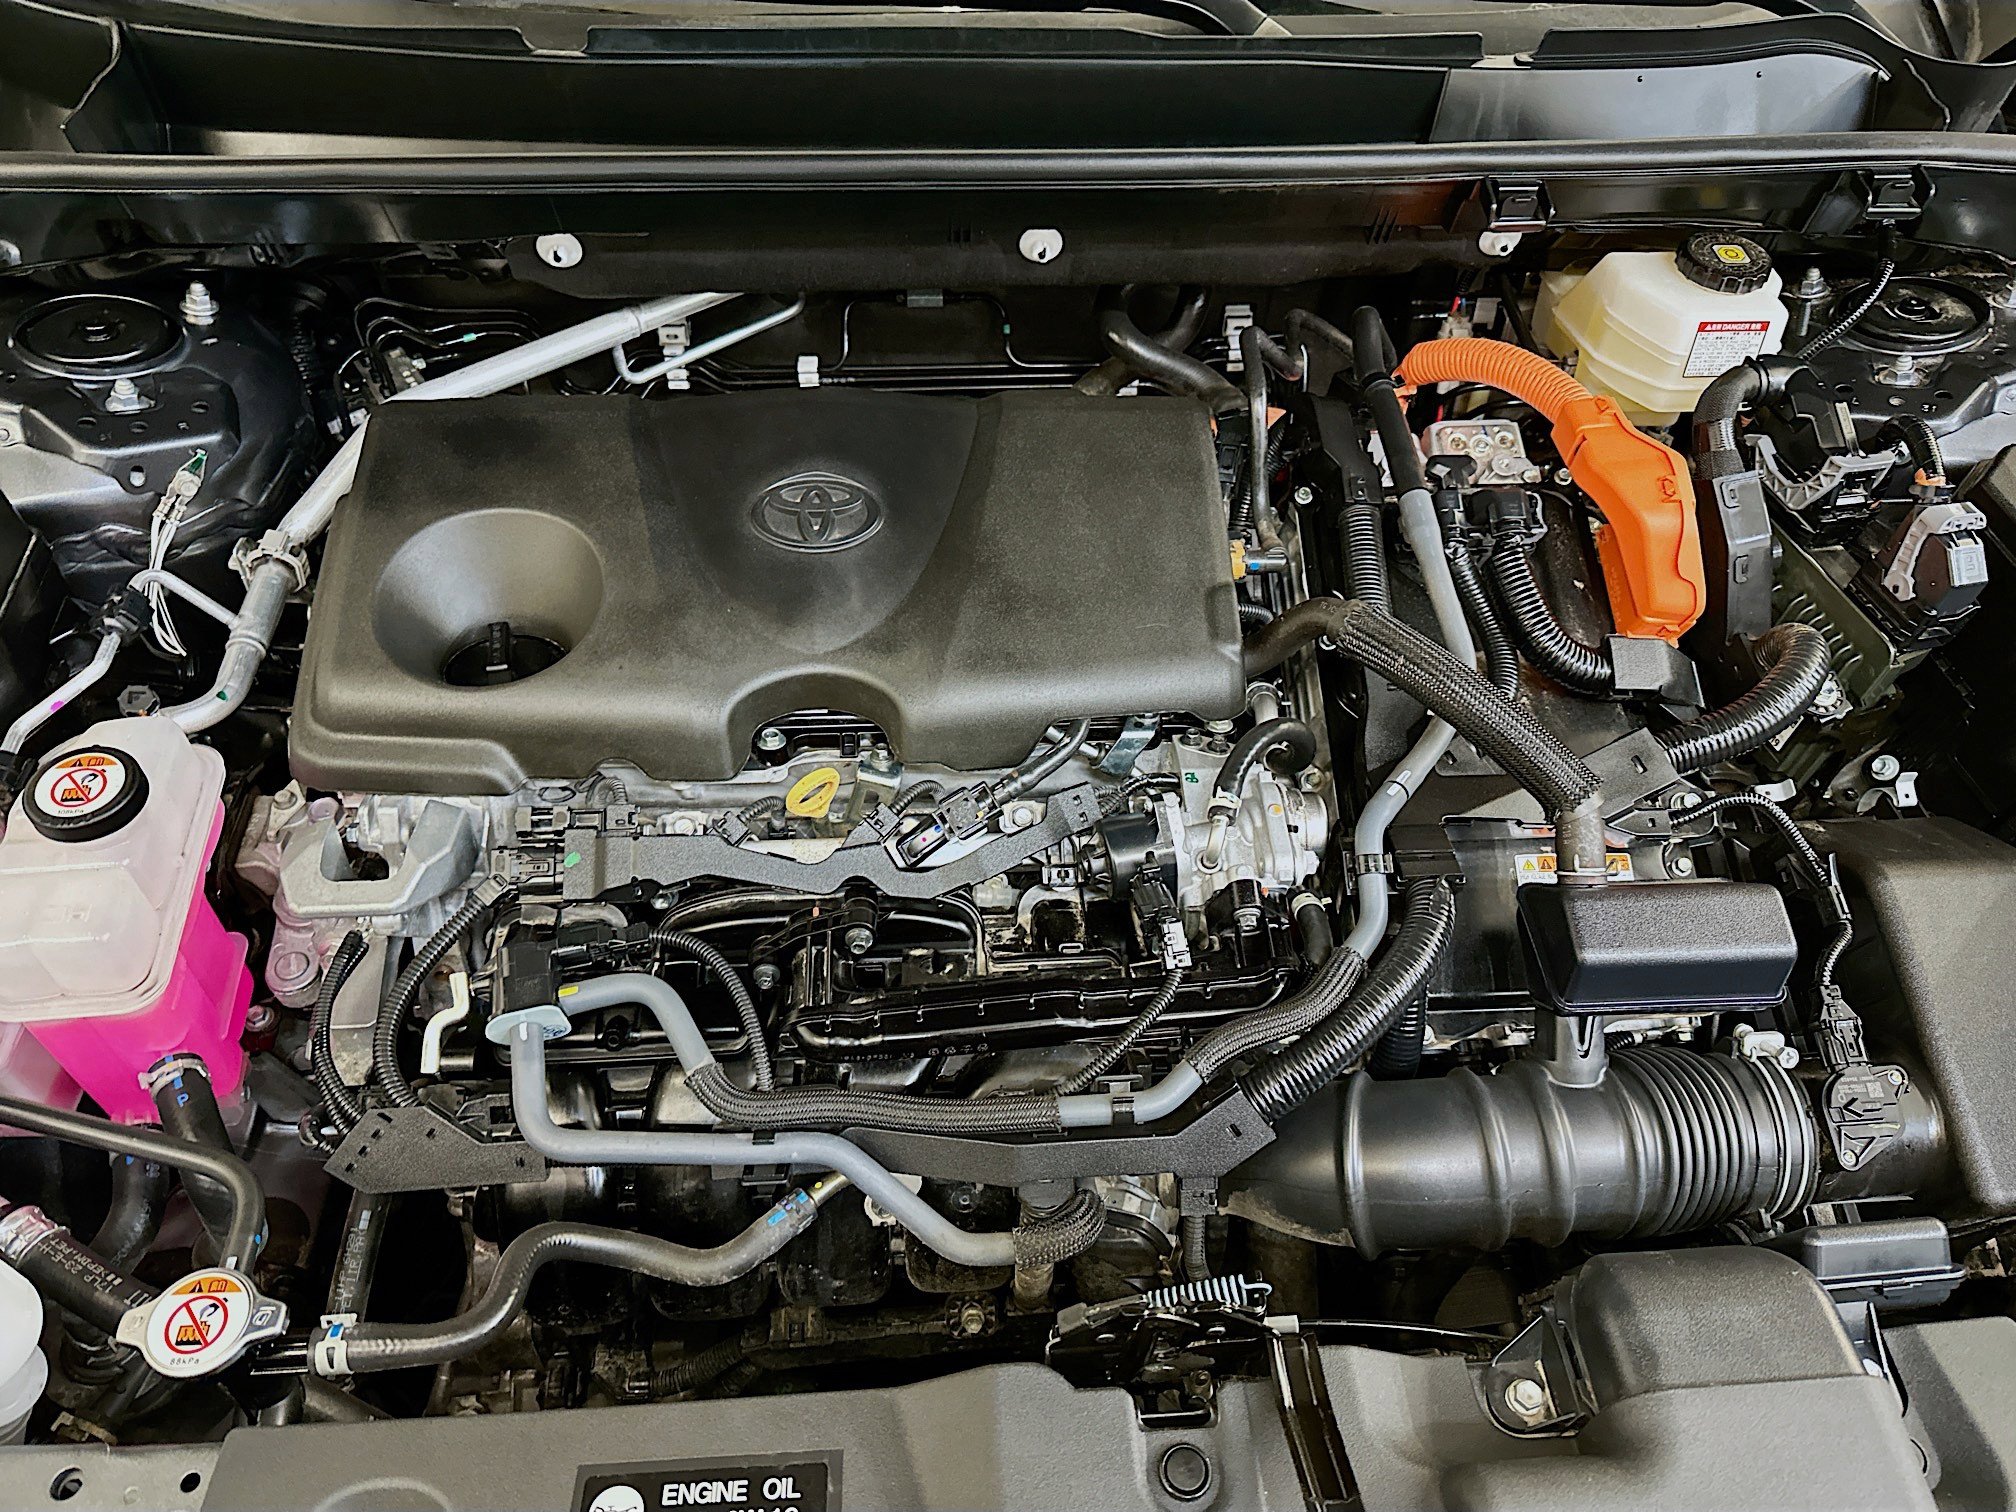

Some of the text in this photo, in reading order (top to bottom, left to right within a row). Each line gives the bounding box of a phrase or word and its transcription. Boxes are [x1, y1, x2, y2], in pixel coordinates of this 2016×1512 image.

[1722, 323, 1750, 331] DANGER
[176, 1092, 188, 1107] P
[169, 1357, 200, 1366] 88kPa
[661, 1477, 801, 1506] ENGINE OIL
